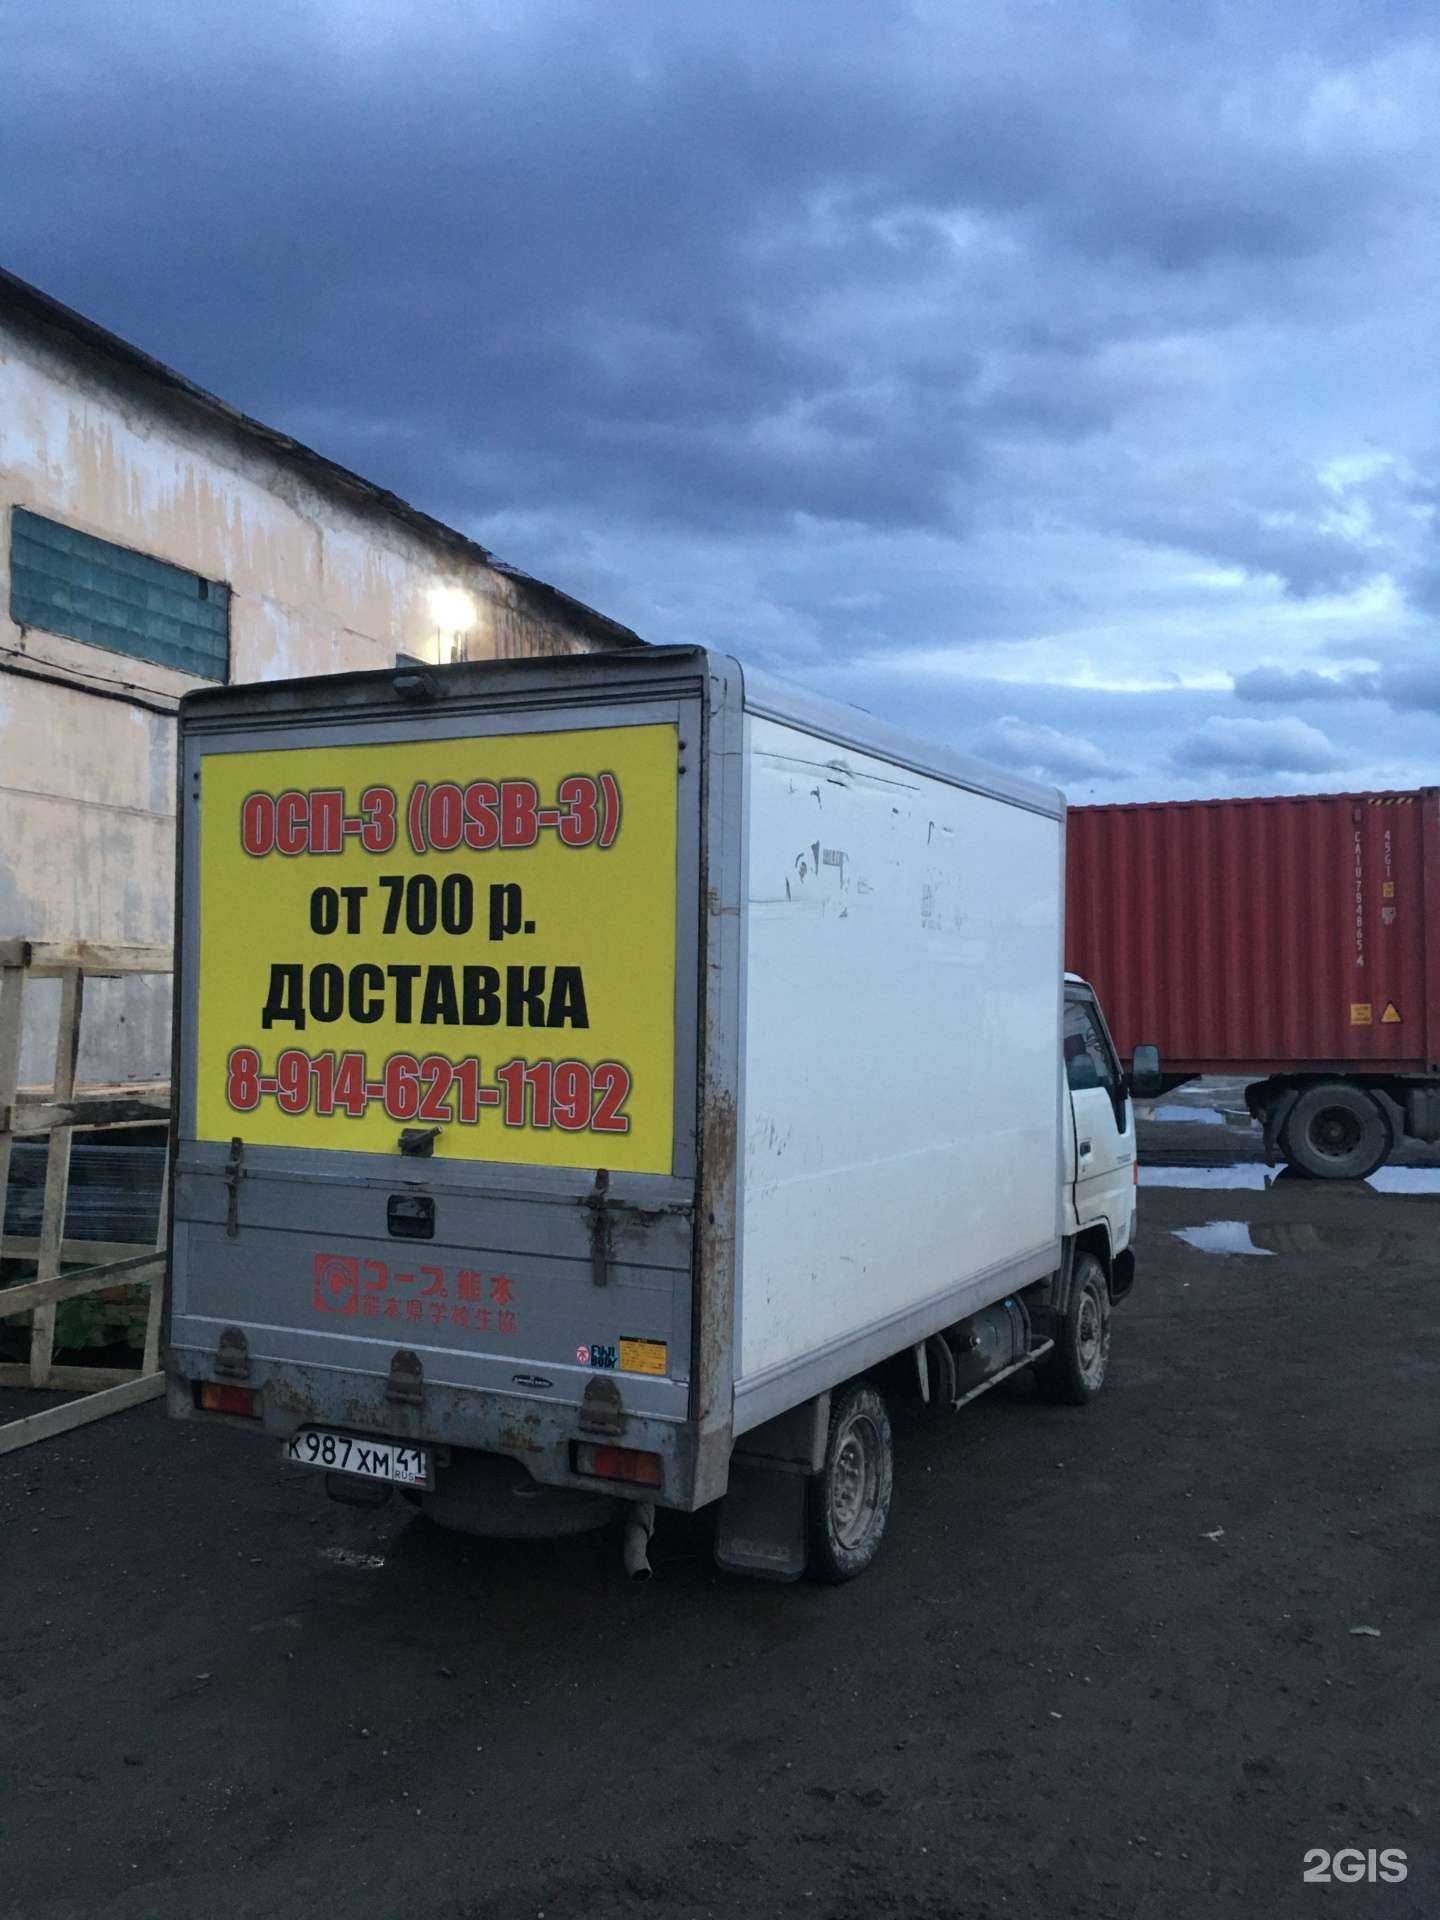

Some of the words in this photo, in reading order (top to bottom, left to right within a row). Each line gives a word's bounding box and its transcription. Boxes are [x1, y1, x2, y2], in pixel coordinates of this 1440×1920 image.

[243, 789, 395, 855] ОСП-3
[409, 776, 620, 852] (OSB-3)
[310, 886, 368, 935] от
[378, 873, 473, 936] 700
[488, 882, 536, 942] р.
[261, 962, 590, 1031] ДОСТАВКА
[229, 1048, 631, 1133] 8-914-621-1192
